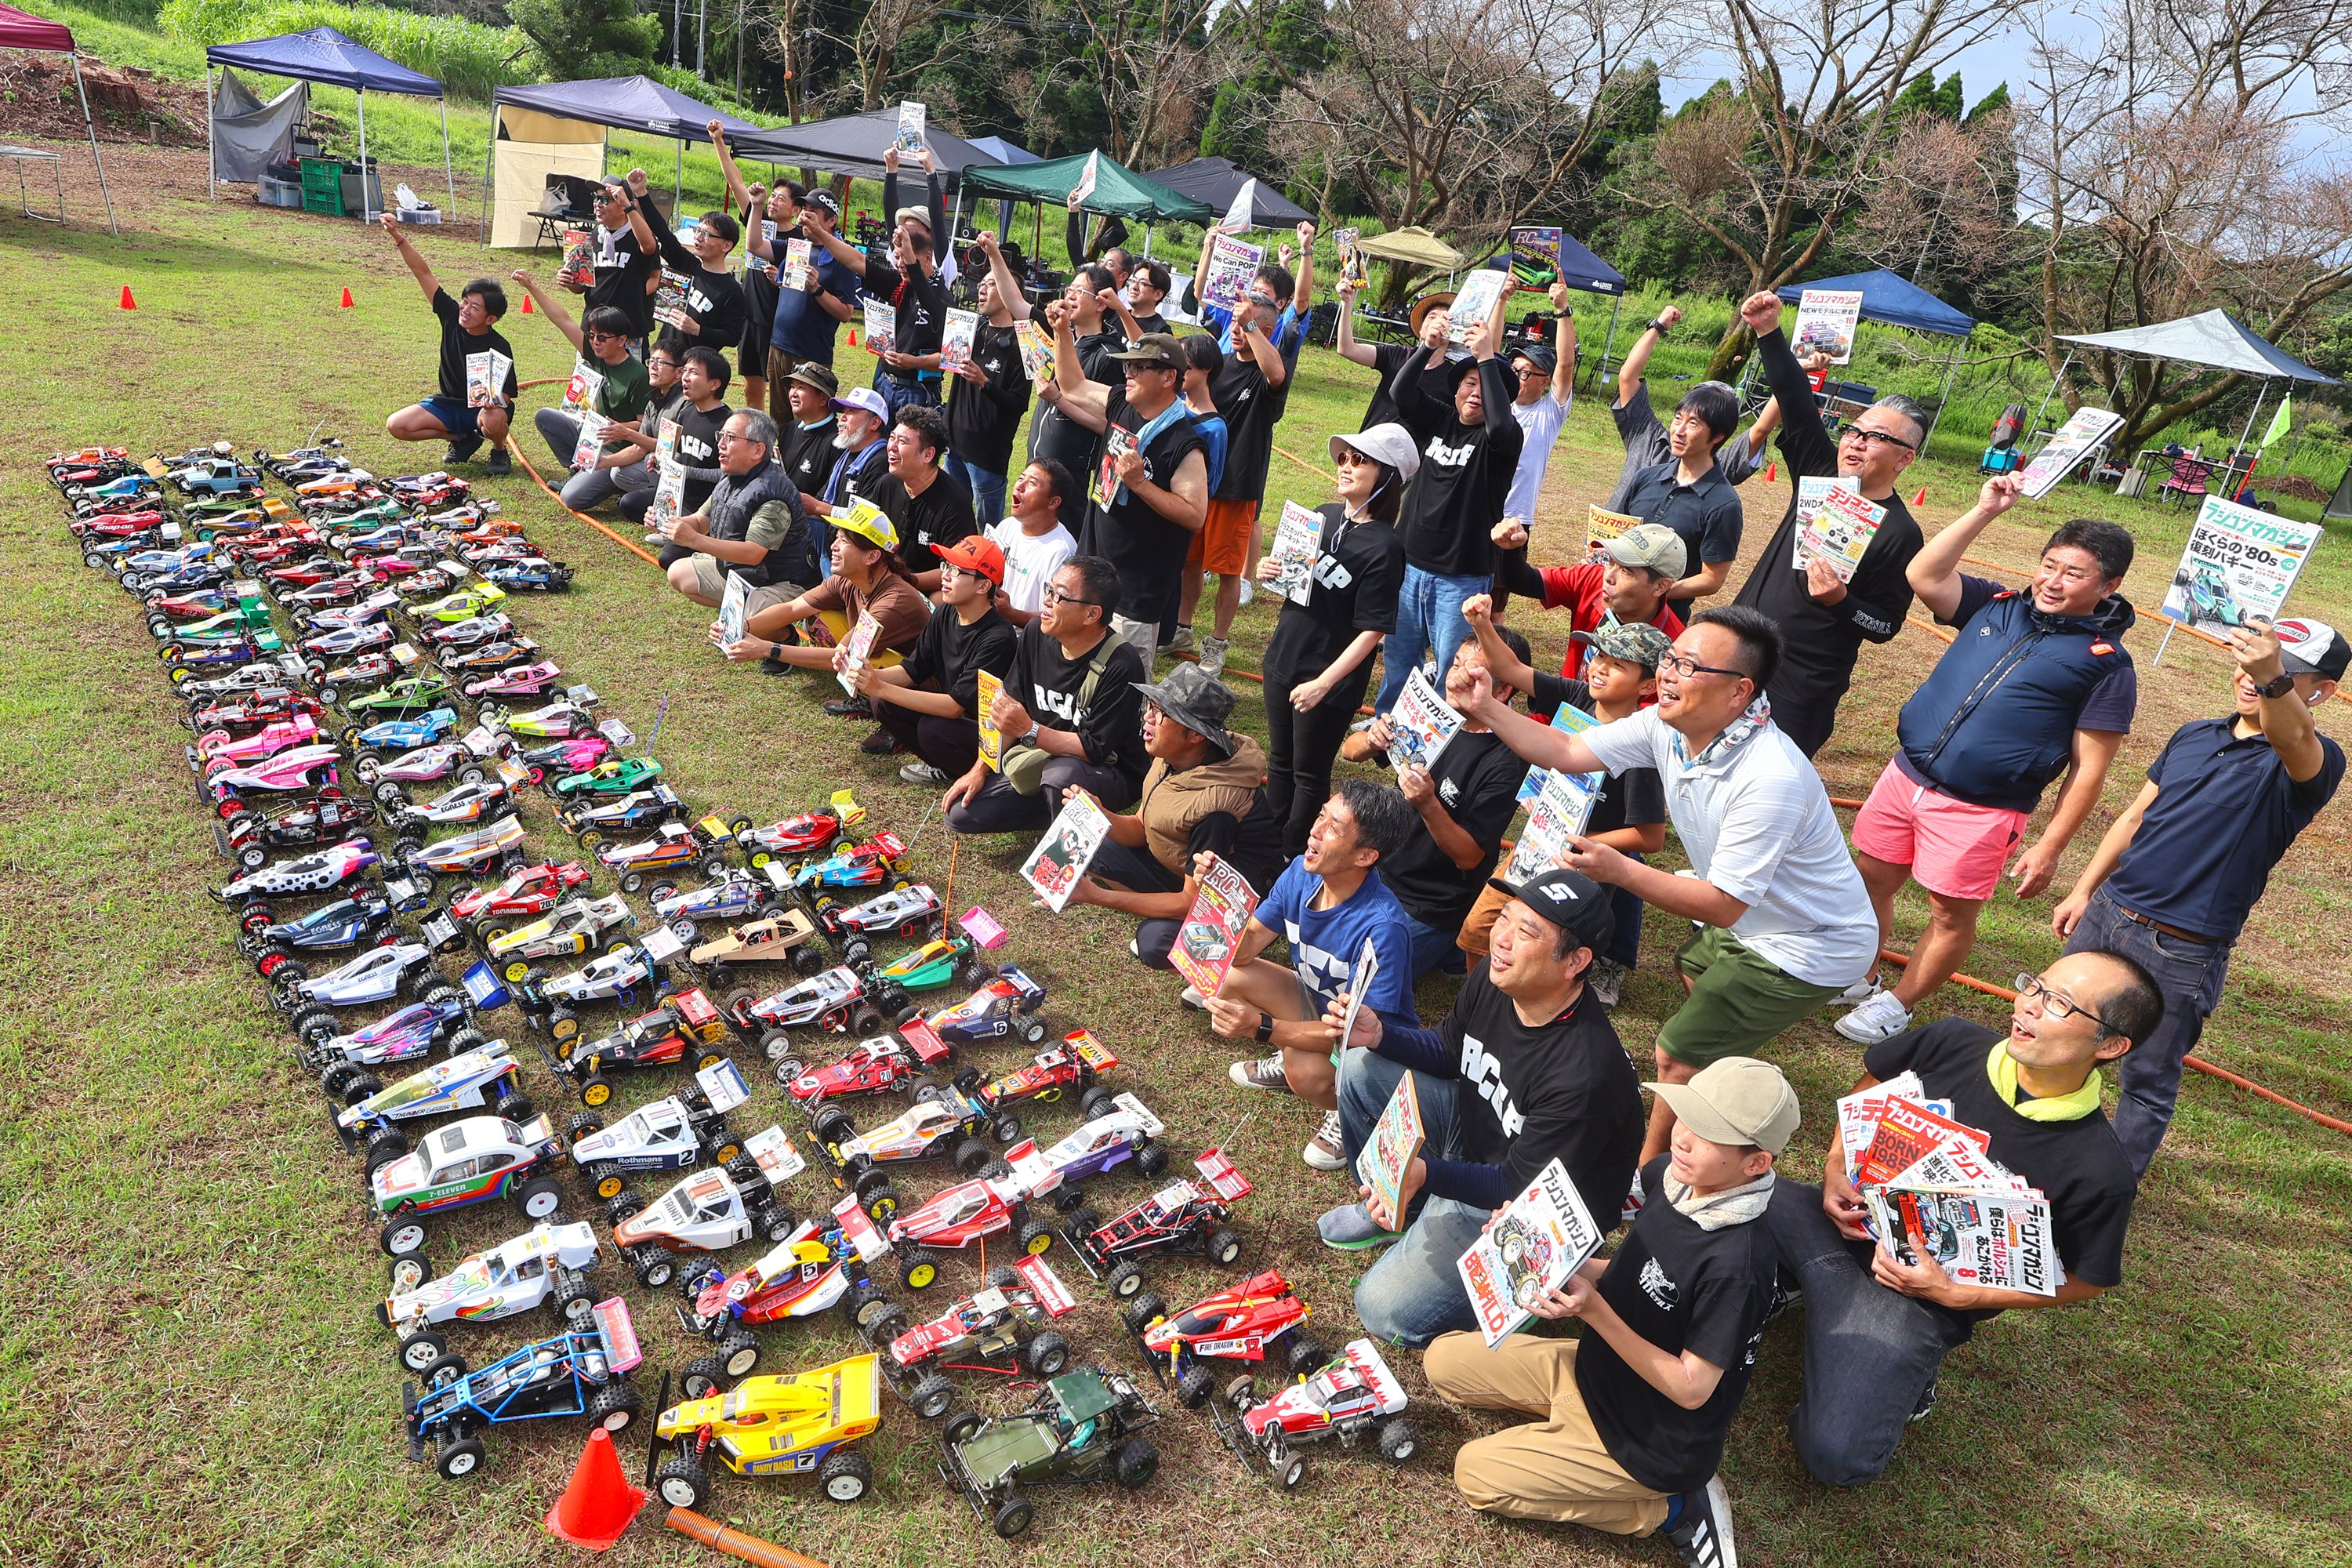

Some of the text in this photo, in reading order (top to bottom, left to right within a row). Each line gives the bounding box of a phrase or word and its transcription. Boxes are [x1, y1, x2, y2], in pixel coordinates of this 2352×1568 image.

[1514, 231, 1537, 244] RC
[1214, 254, 1257, 271] We Can POP!
[689, 286, 713, 313] GP
[1805, 293, 1860, 305] ラジコンマガジン
[1828, 485, 1874, 513] ラジコン
[2205, 502, 2313, 546] ラジコンマガジン
[1310, 536, 1317, 546] 11
[2190, 539, 2254, 571] 復刻バギー
[2270, 583, 2286, 597] 2
[1402, 689, 1426, 725] よみがえる
[1409, 673, 1457, 728] ラジコンマガジン
[1424, 731, 1432, 742] 6
[1544, 772, 1583, 814] ラジコンマガジン
[441, 800, 466, 812] EGNESS
[1063, 798, 1091, 826] RC
[833, 870, 840, 879] 5
[1203, 862, 1241, 896] RC
[492, 907, 528, 916] TOMAHAWK
[539, 899, 555, 909] 203
[310, 920, 343, 935] EGNESS
[557, 942, 575, 953] 204
[577, 989, 588, 1000] 8
[824, 997, 832, 1006] 2
[995, 1022, 1006, 1034] 6
[614, 1045, 626, 1057] 5
[880, 1071, 891, 1082] 20
[1398, 1075, 1413, 1131] ラジコン
[1886, 1099, 1984, 1150] ラジコンマガ
[1875, 1130, 1919, 1161] BORN
[617, 1155, 664, 1165] Rothmans
[680, 1149, 694, 1164] 2
[1871, 1144, 1911, 1173] 1985
[427, 1183, 466, 1199] 7-ELEVEN
[1528, 1188, 1541, 1203] 4
[662, 1196, 685, 1227] TRINITY
[1542, 1166, 1589, 1250] ラジコンマガジン
[735, 1226, 746, 1242] 1
[1987, 1207, 2009, 1287] 僕らはポルシェに
[2020, 1203, 2045, 1293] ラジコンマガジン
[1976, 1235, 1994, 1284] あこがれる
[803, 1262, 817, 1278] 5
[1957, 1268, 1977, 1278] 8
[1023, 1265, 1064, 1312] SAMURAI
[1199, 1340, 1234, 1353] FIRE DRAGON
[752, 1459, 795, 1475] DANDY DASH
[798, 1454, 815, 1467] 7
